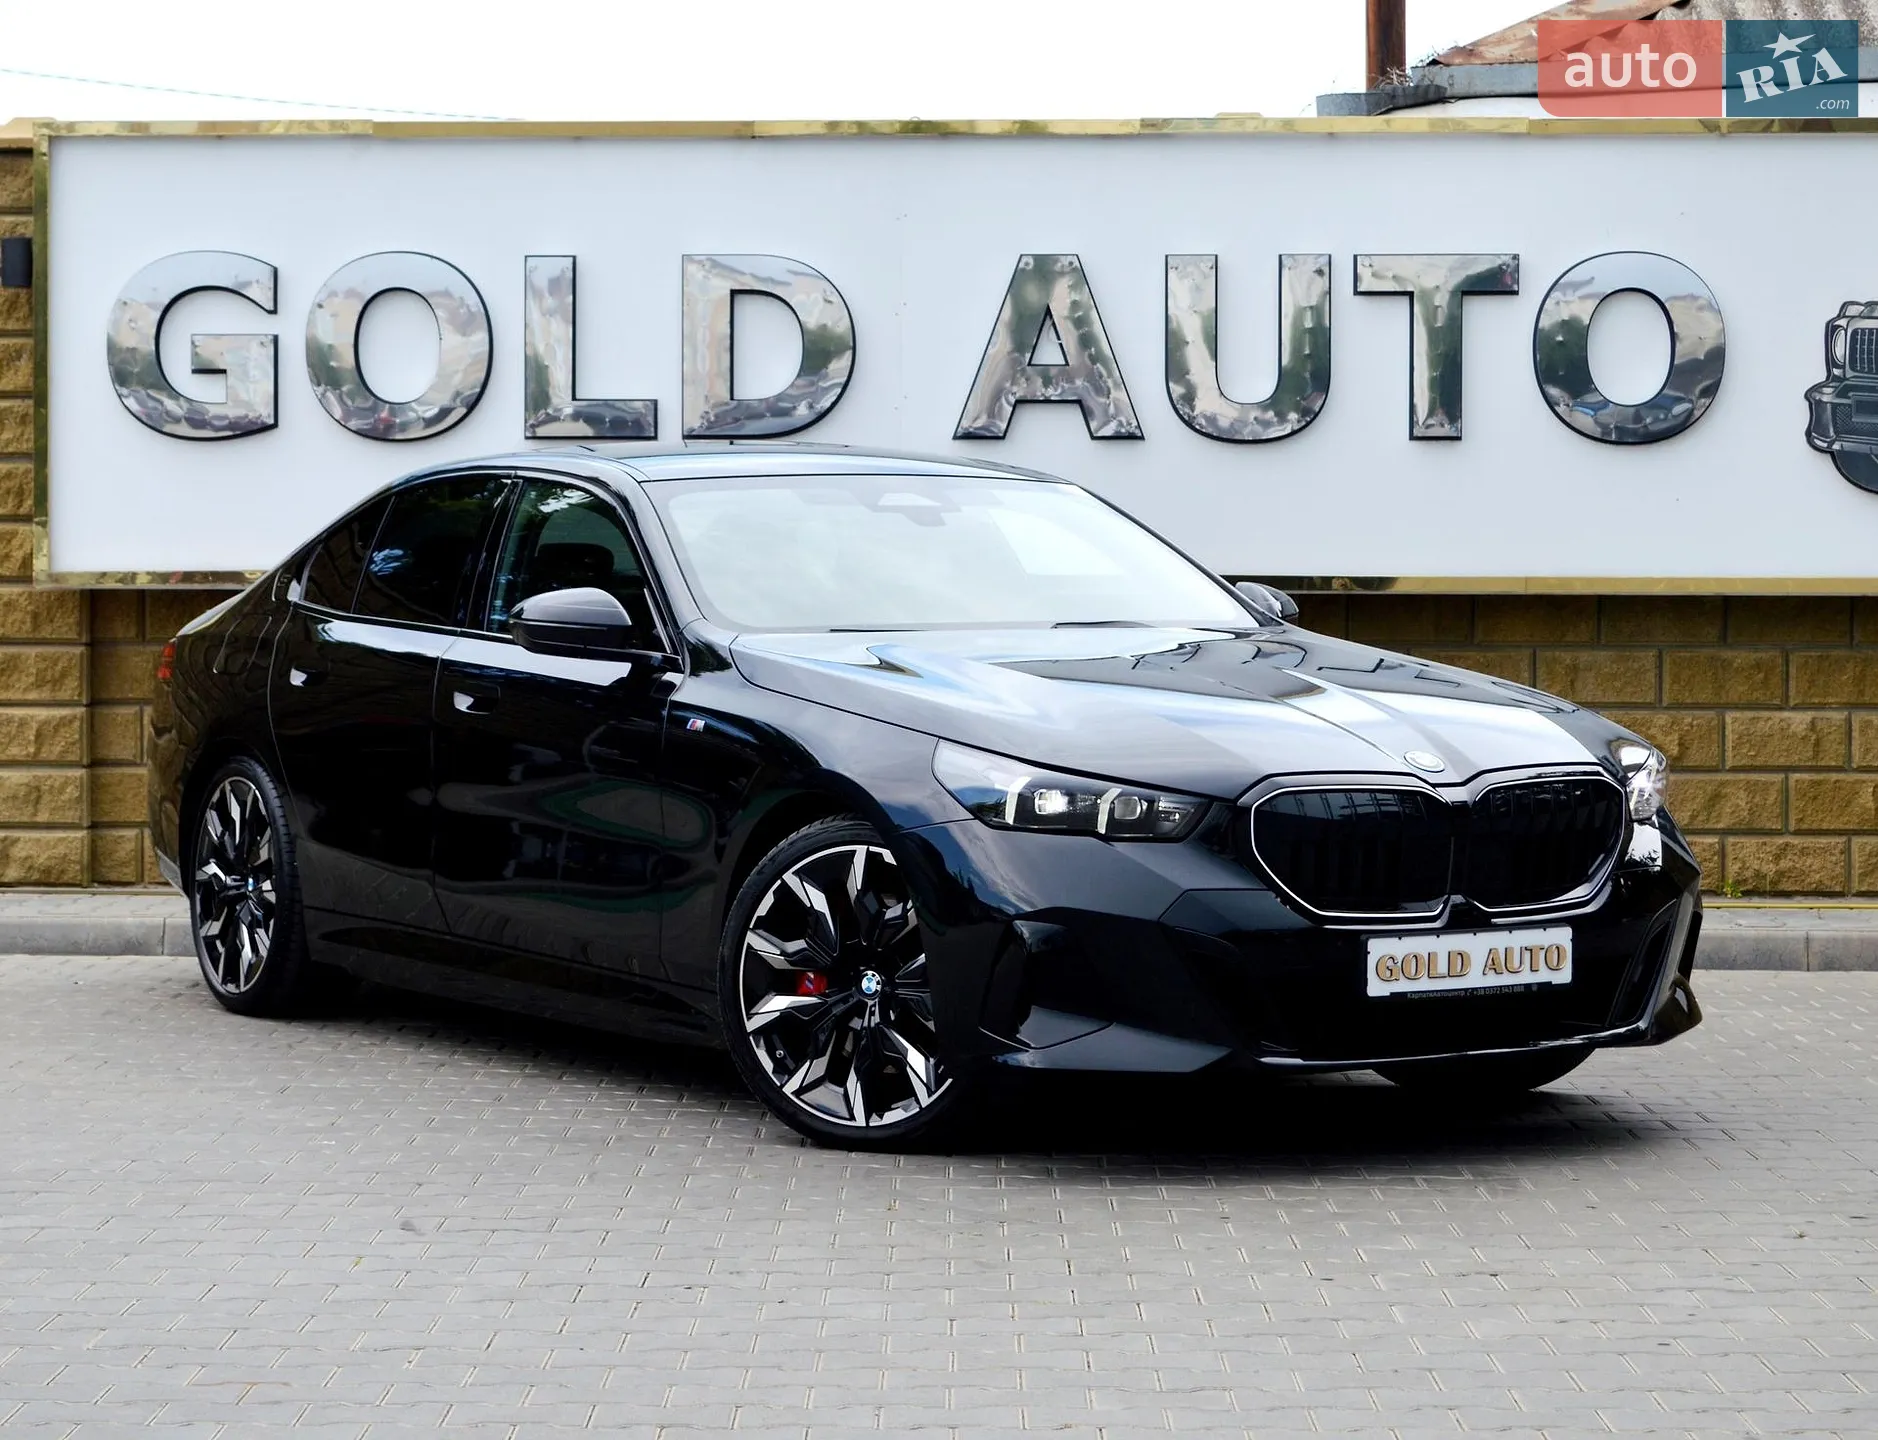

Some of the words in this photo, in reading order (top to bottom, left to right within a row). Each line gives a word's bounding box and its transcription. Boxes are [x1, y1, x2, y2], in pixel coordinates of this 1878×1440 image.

[106, 250, 857, 442] GOLD
[952, 250, 1728, 445] AUTO
[1376, 950, 1472, 982] GOLD
[1483, 943, 1568, 976] AUTO
